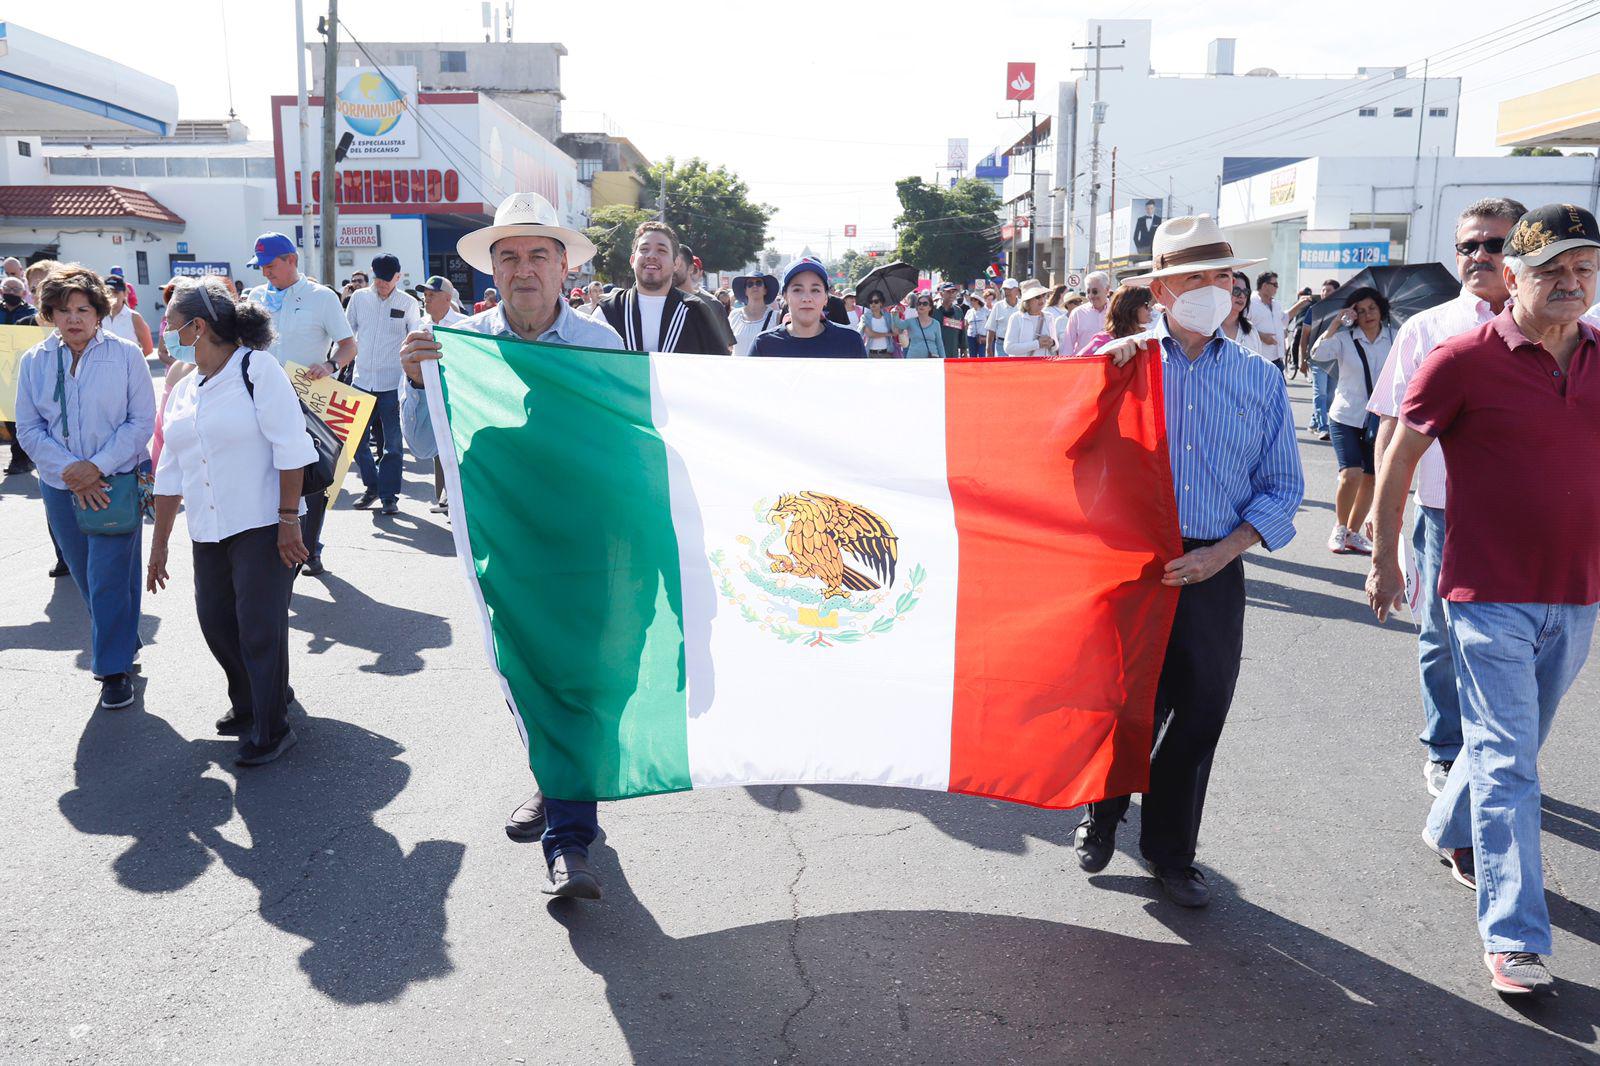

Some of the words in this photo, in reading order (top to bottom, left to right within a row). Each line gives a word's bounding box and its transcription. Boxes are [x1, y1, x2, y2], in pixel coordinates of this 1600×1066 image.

[341, 226, 373, 236] ABIERTO
[340, 236, 350, 245] 24
[351, 236, 377, 245] HORAS
[1301, 249, 1341, 263] REGULAR
[174, 264, 228, 276] gasolina
